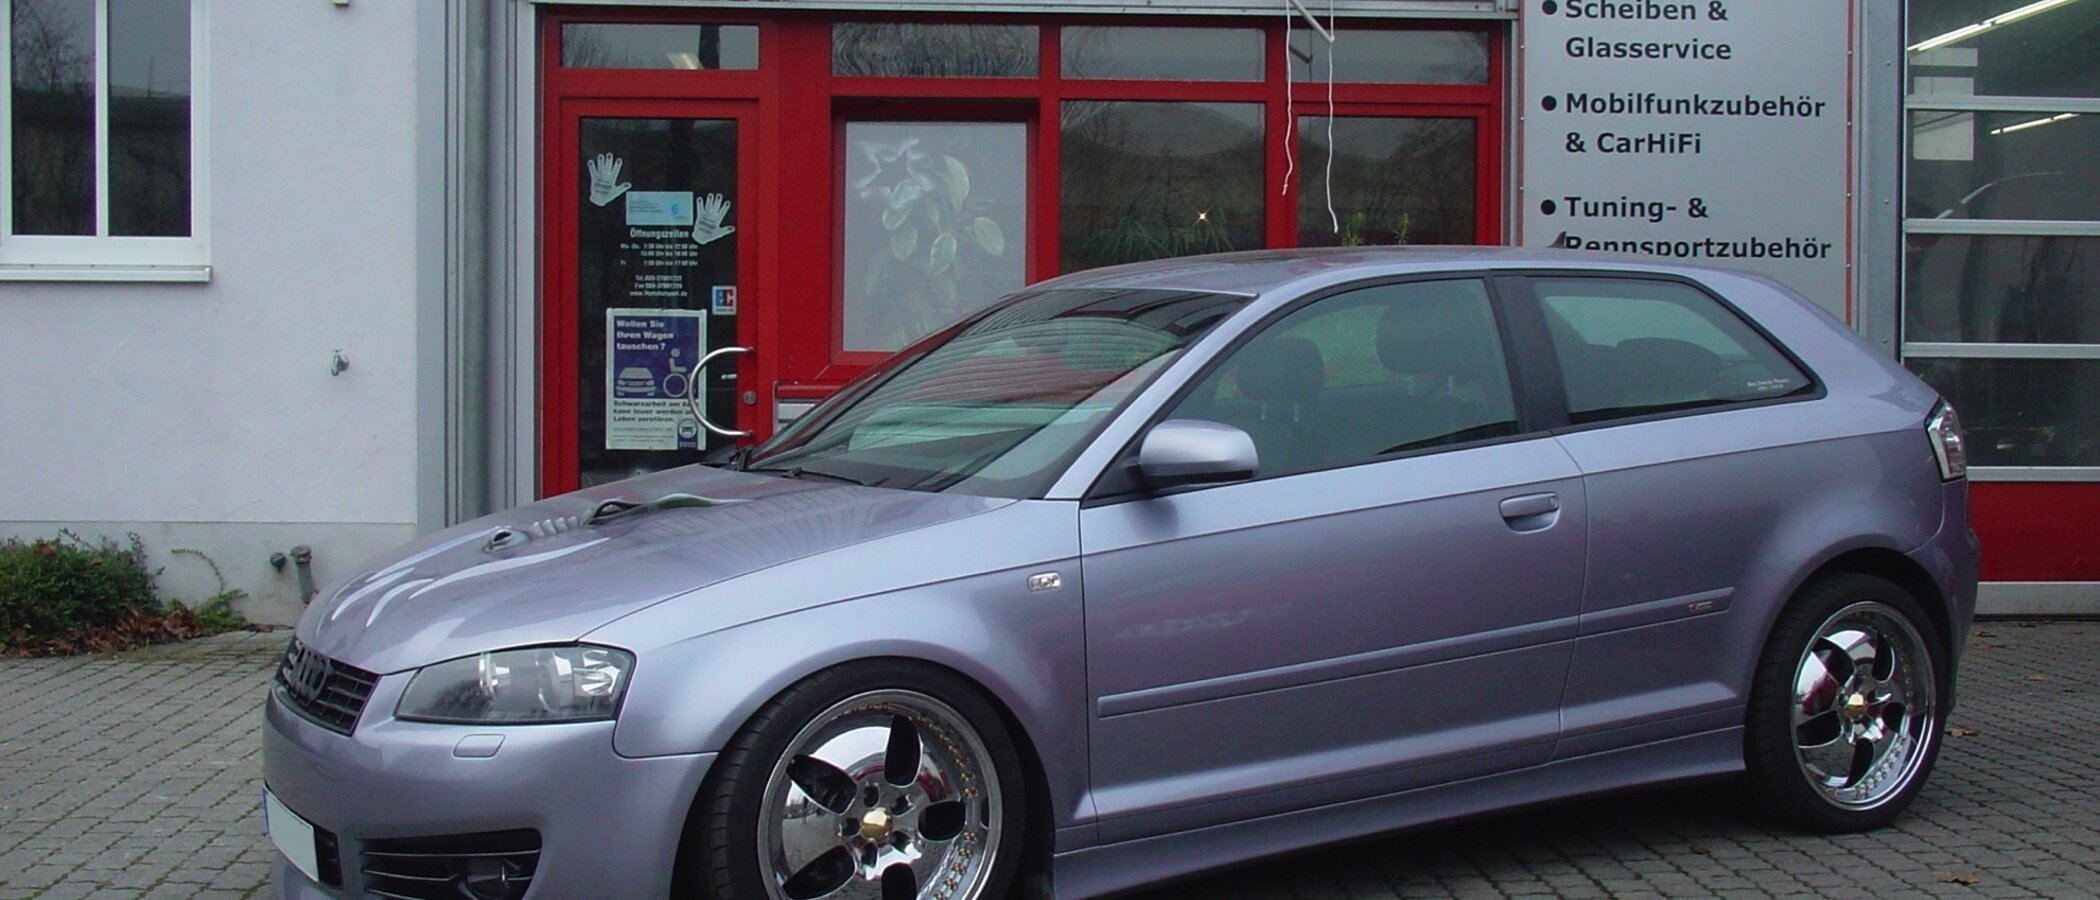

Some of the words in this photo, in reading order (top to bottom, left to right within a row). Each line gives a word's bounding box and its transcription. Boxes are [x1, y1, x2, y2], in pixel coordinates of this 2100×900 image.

[1565, 0, 1697, 20] Scheiben
[1707, 1, 1728, 21] &
[1565, 37, 1732, 60] Glasservice
[1566, 93, 1826, 117] Mobilfunkzubehör
[1565, 132, 1586, 154] &
[1596, 133, 1701, 154] CarHiFi
[1564, 196, 1677, 223] Tuning-
[1687, 197, 1709, 219] &
[616, 320, 647, 328] Wollen
[650, 320, 665, 328] Sie
[616, 331, 641, 339] Ihren
[643, 332, 674, 341] Wagen
